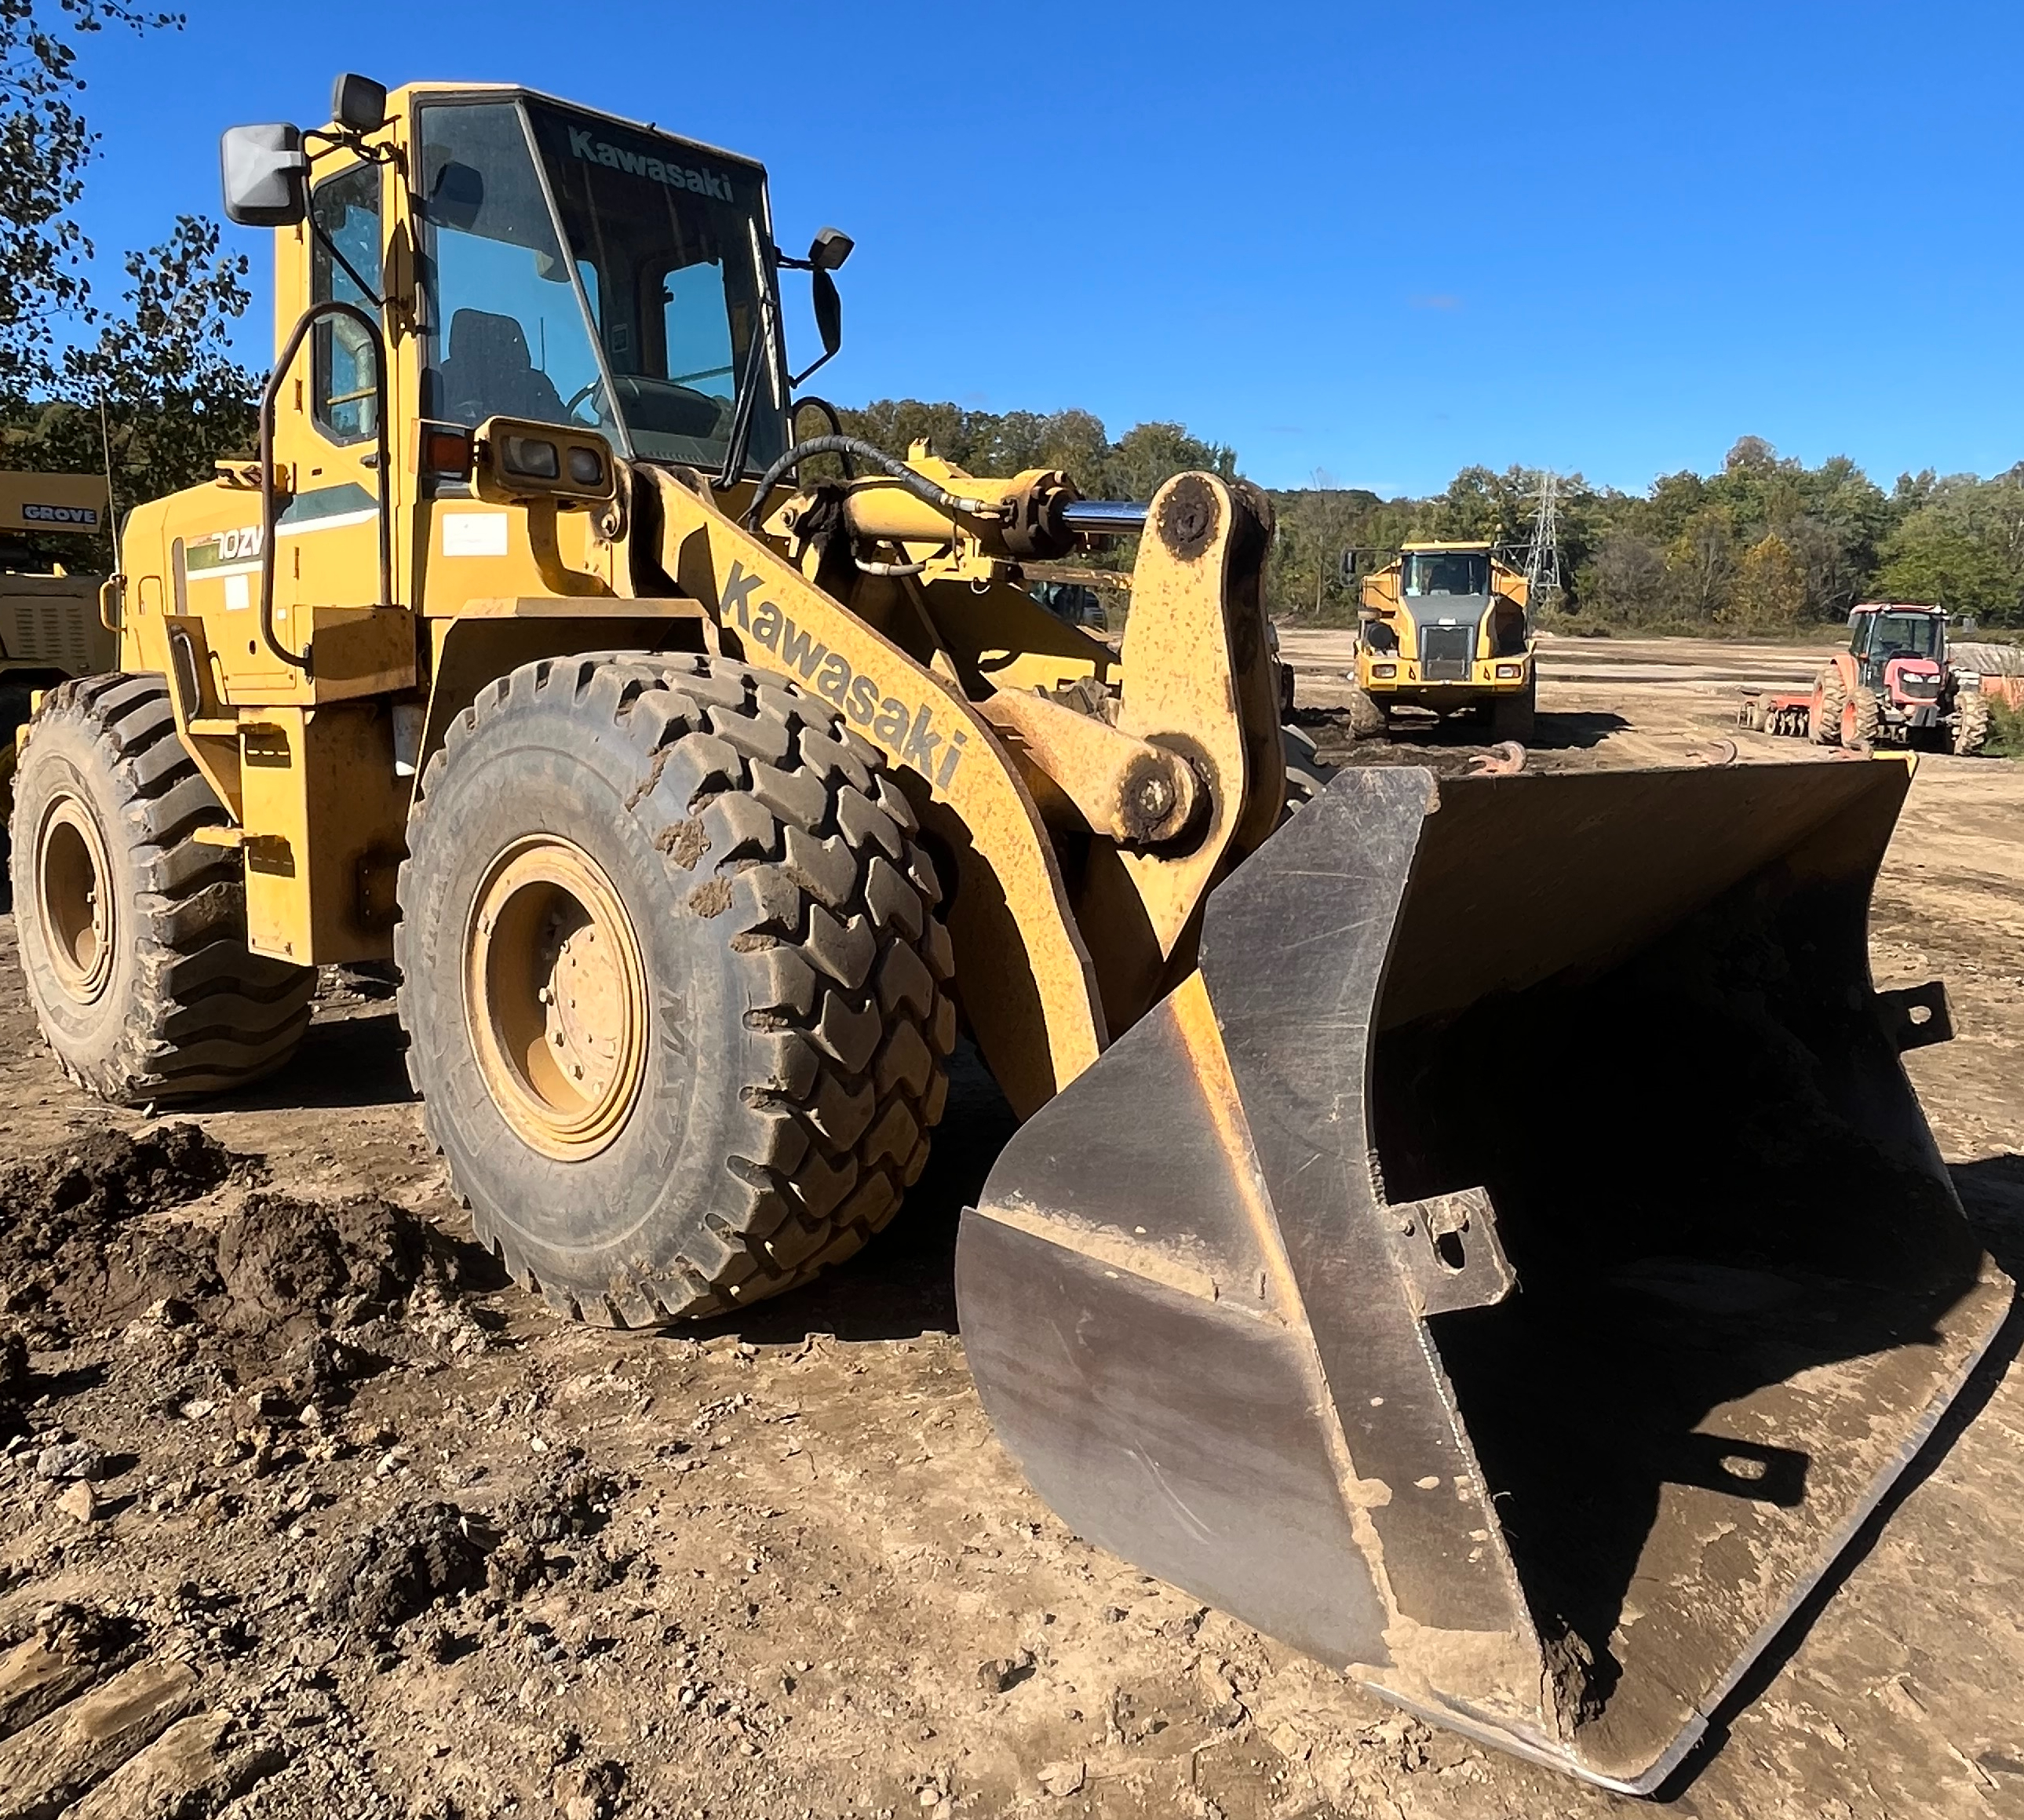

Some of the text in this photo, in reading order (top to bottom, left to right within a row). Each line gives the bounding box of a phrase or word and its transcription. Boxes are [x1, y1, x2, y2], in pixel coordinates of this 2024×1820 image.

[567, 125, 734, 203] Kawasaki
[24, 505, 96, 523] GROVE
[720, 559, 968, 790] Kawasaki
